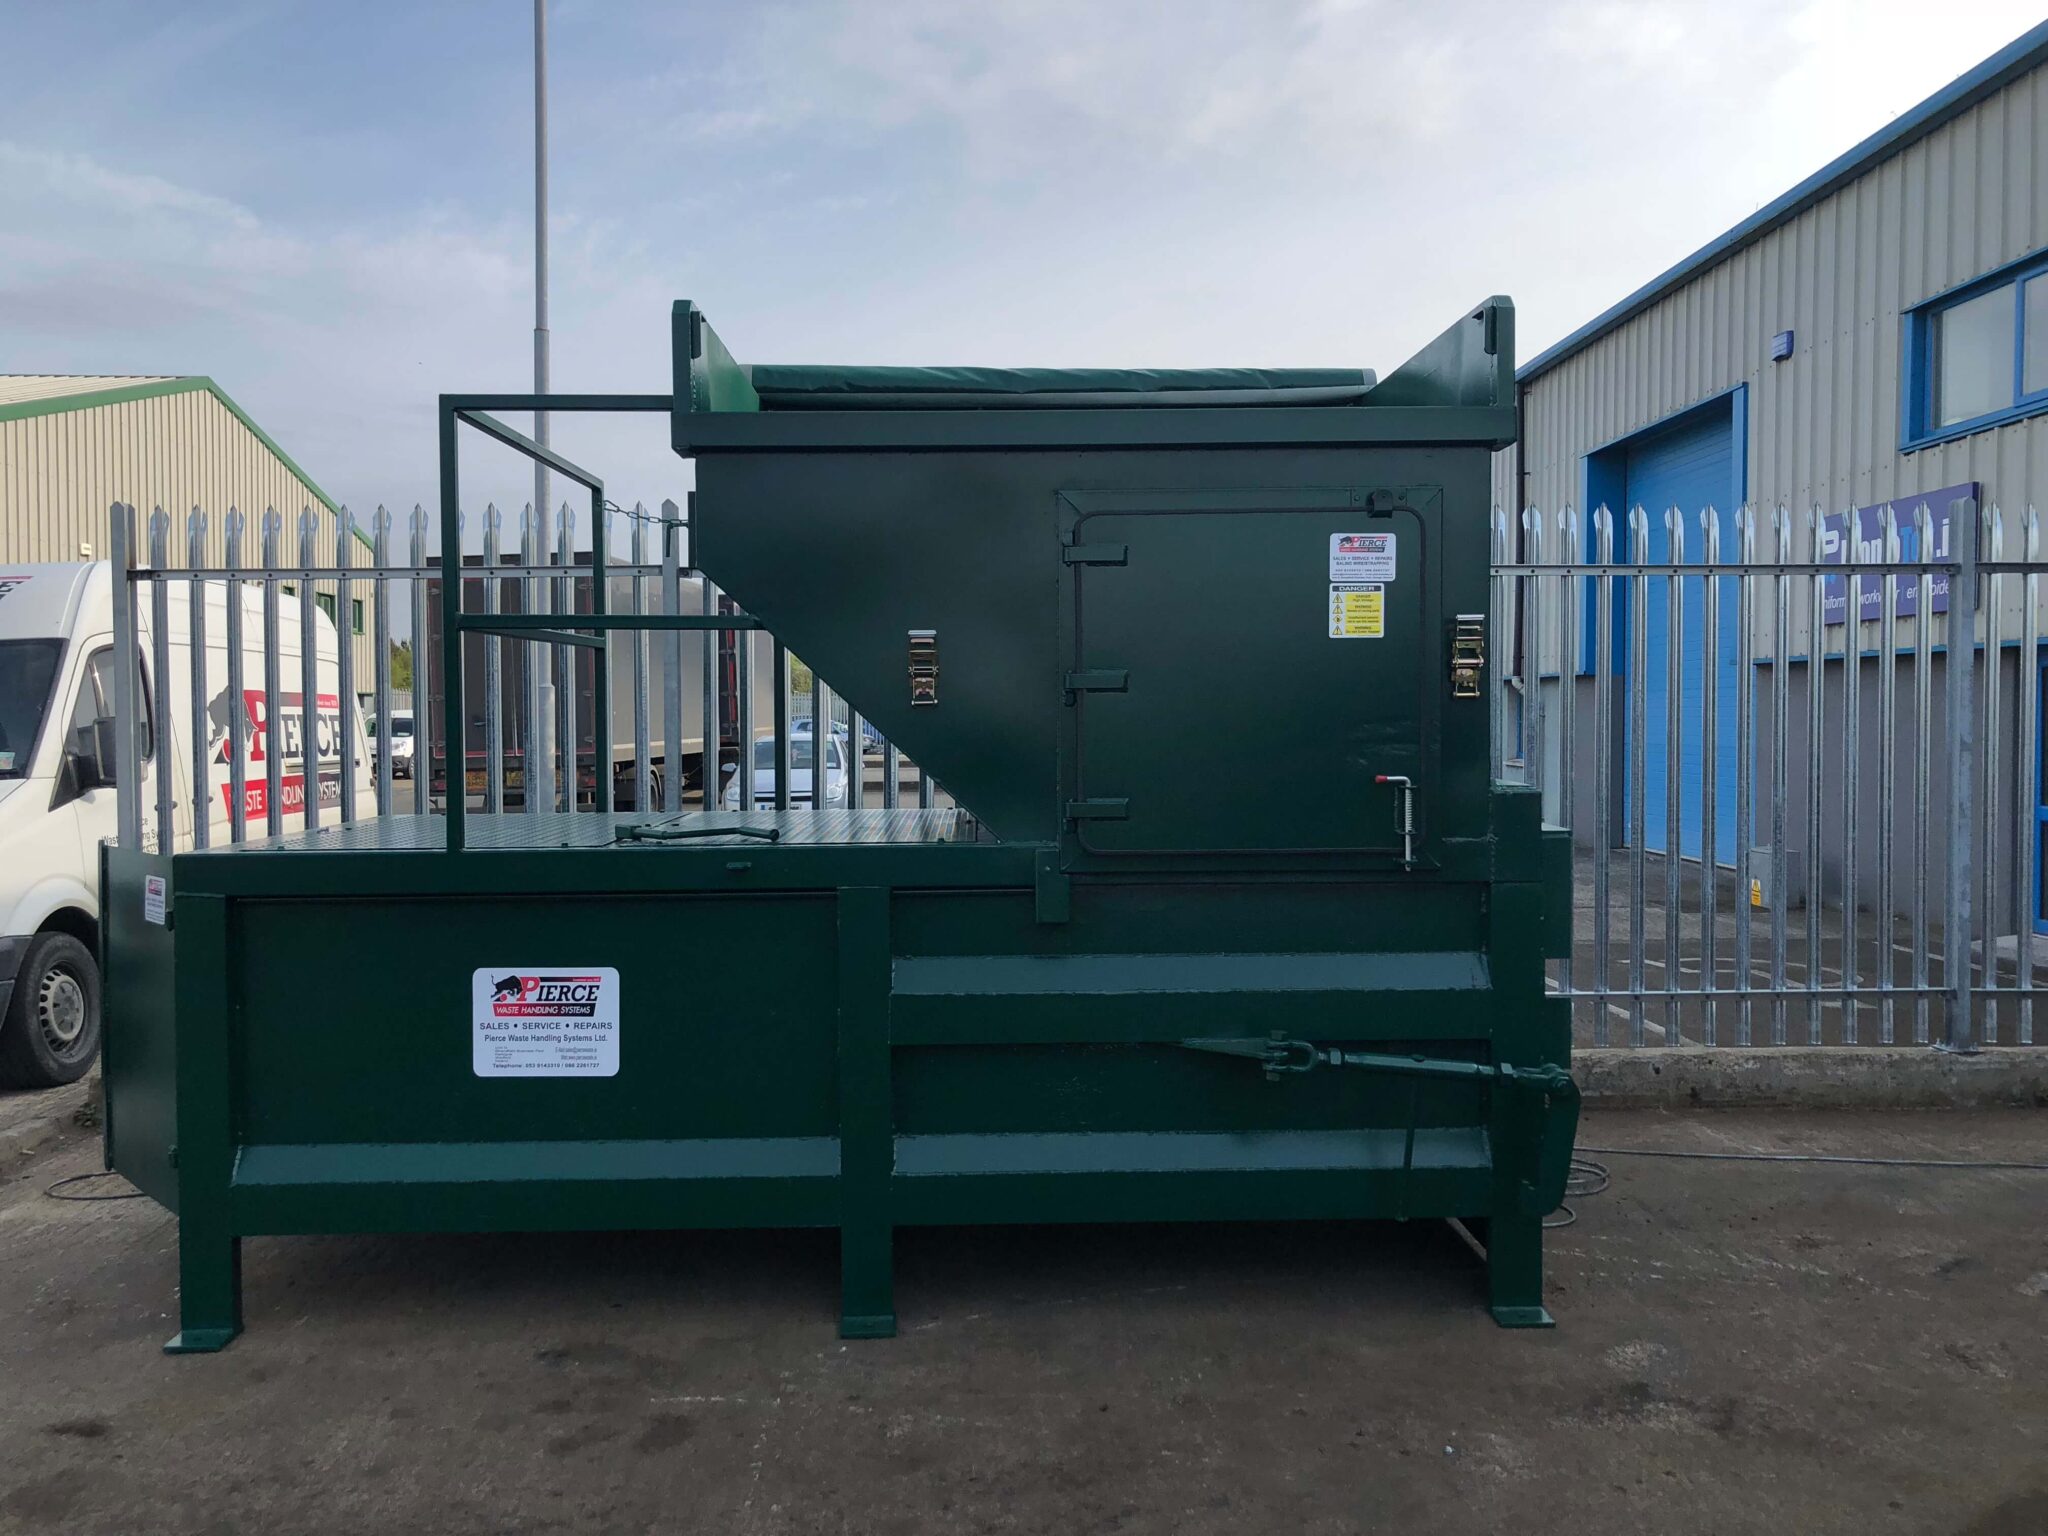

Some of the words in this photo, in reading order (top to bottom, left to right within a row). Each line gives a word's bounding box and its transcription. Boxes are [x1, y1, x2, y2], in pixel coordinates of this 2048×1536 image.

[1351, 536, 1387, 547] PIERCE
[516, 976, 600, 1002] PIERCE
[496, 1006, 519, 1014] WASTE
[521, 1006, 559, 1014] HANDLING
[561, 1006, 591, 1014] SYSTEMS
[480, 1022, 510, 1030] SALES
[522, 1022, 561, 1030] SERVICE
[573, 1022, 613, 1030] REPAIRS
[485, 1034, 507, 1042] Pierce
[508, 1034, 529, 1042] Waste
[531, 1034, 561, 1043] Handling
[563, 1034, 592, 1043] Systems
